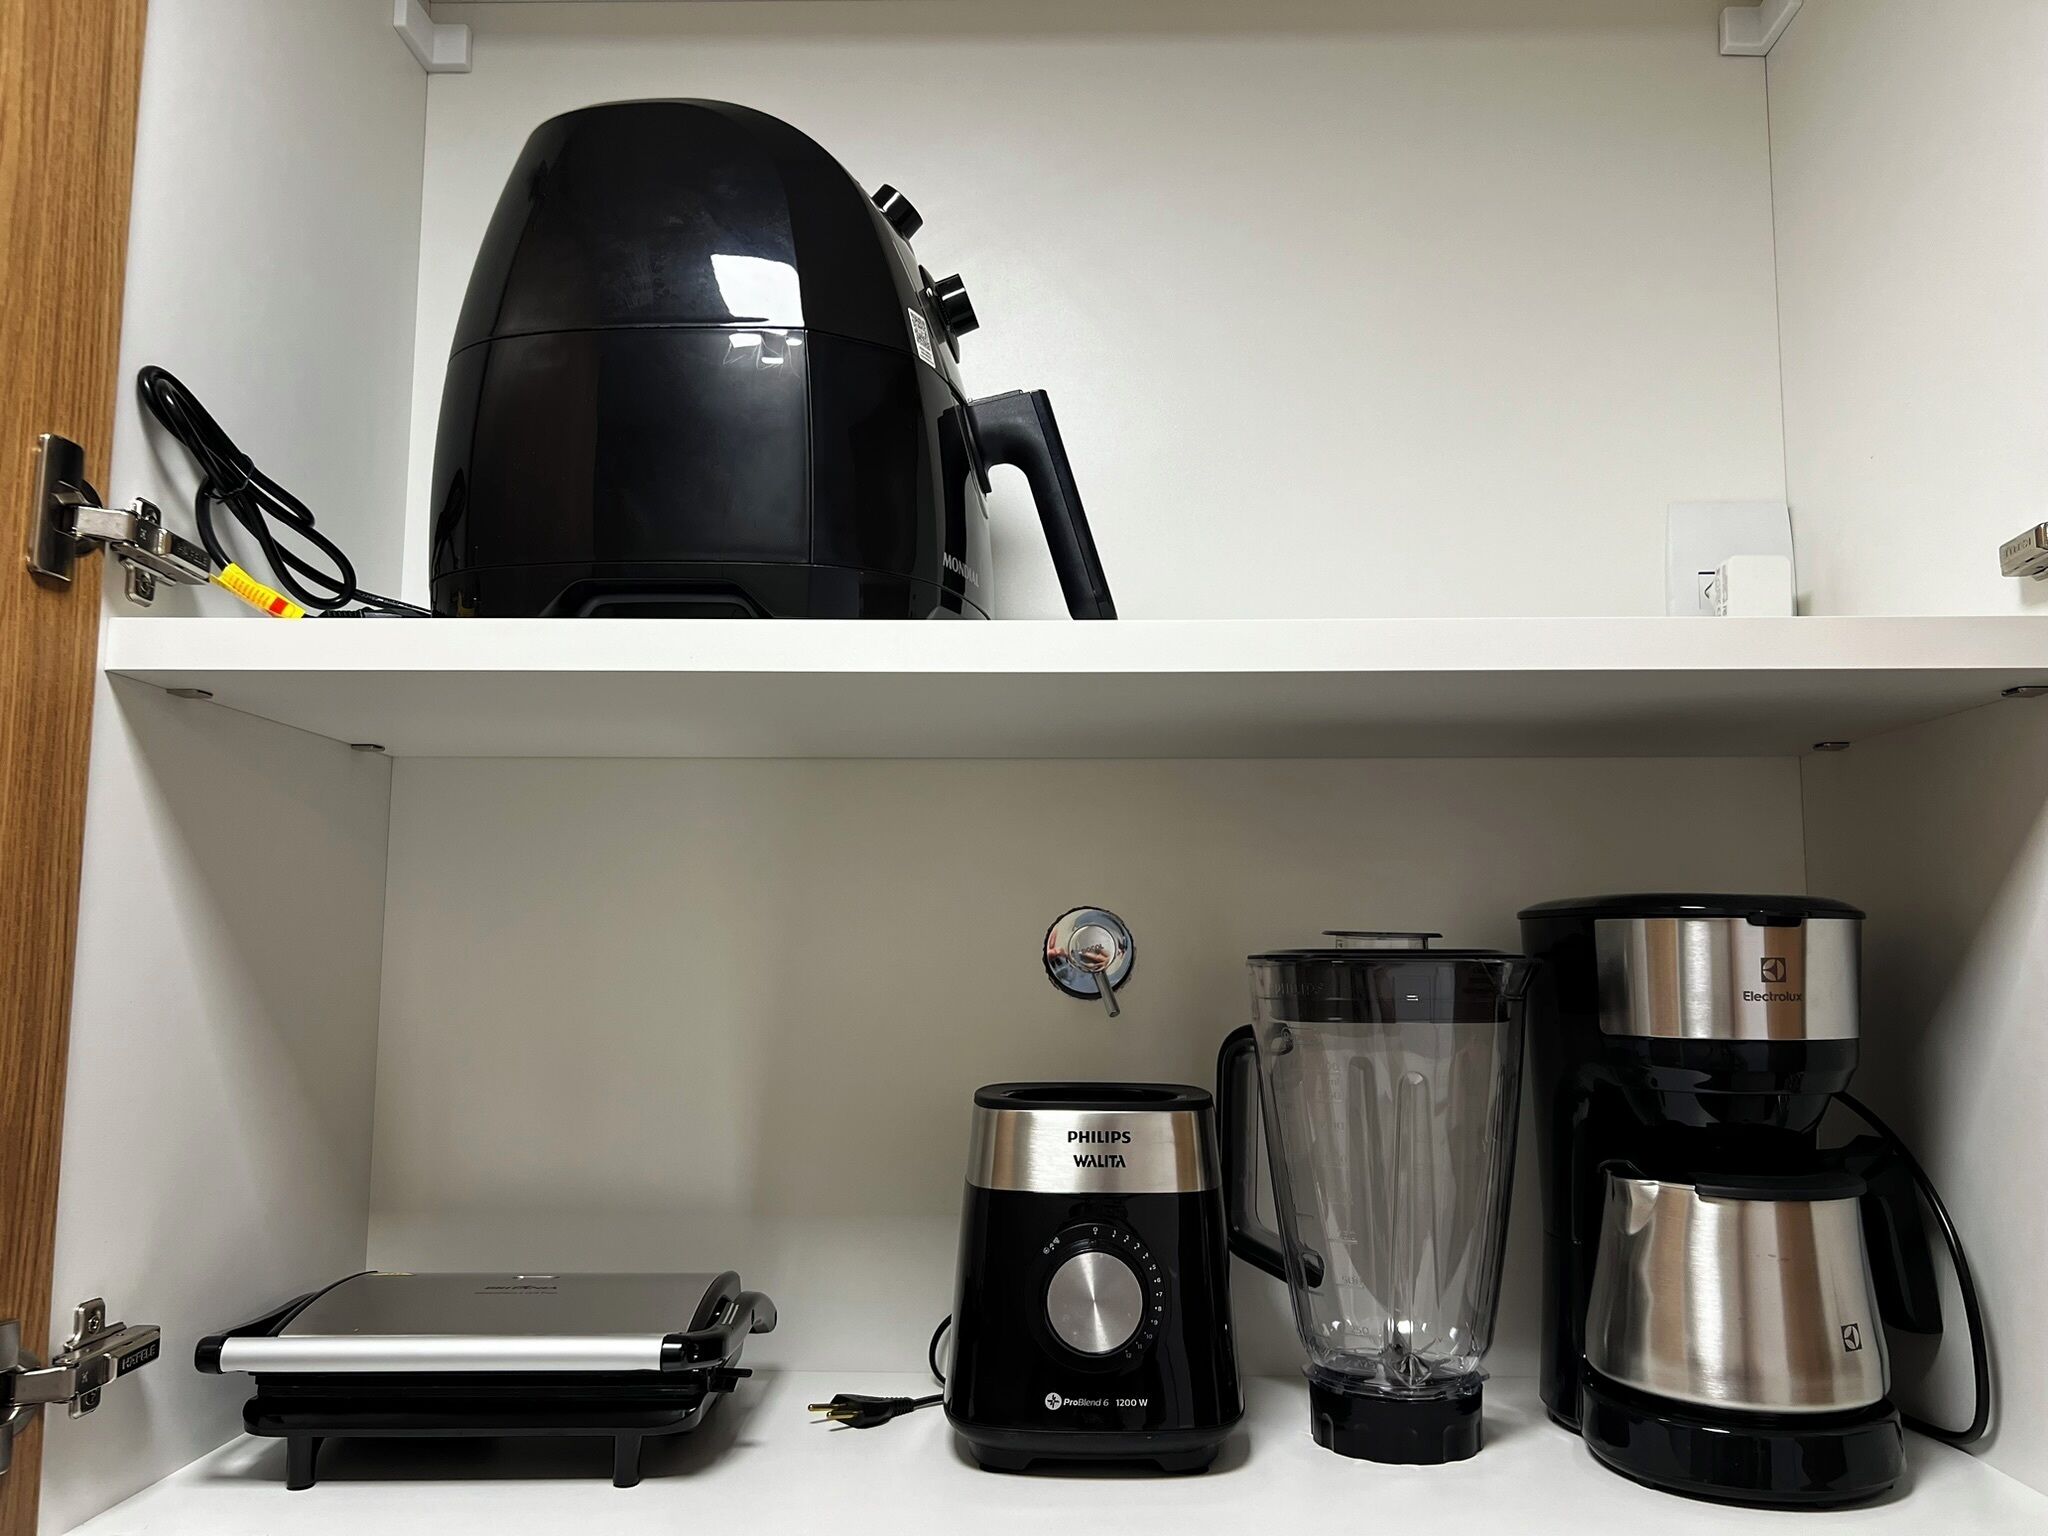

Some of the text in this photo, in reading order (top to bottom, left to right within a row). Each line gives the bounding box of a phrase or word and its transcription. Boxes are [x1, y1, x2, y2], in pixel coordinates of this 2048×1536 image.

[942, 551, 979, 588] MONDIAL
[1742, 990, 1803, 1002] Electrolux
[1067, 1130, 1132, 1144] PHILIPS
[1072, 1154, 1127, 1168] WALITA
[1063, 1398, 1148, 1407] ProBlend 6 1200 W
